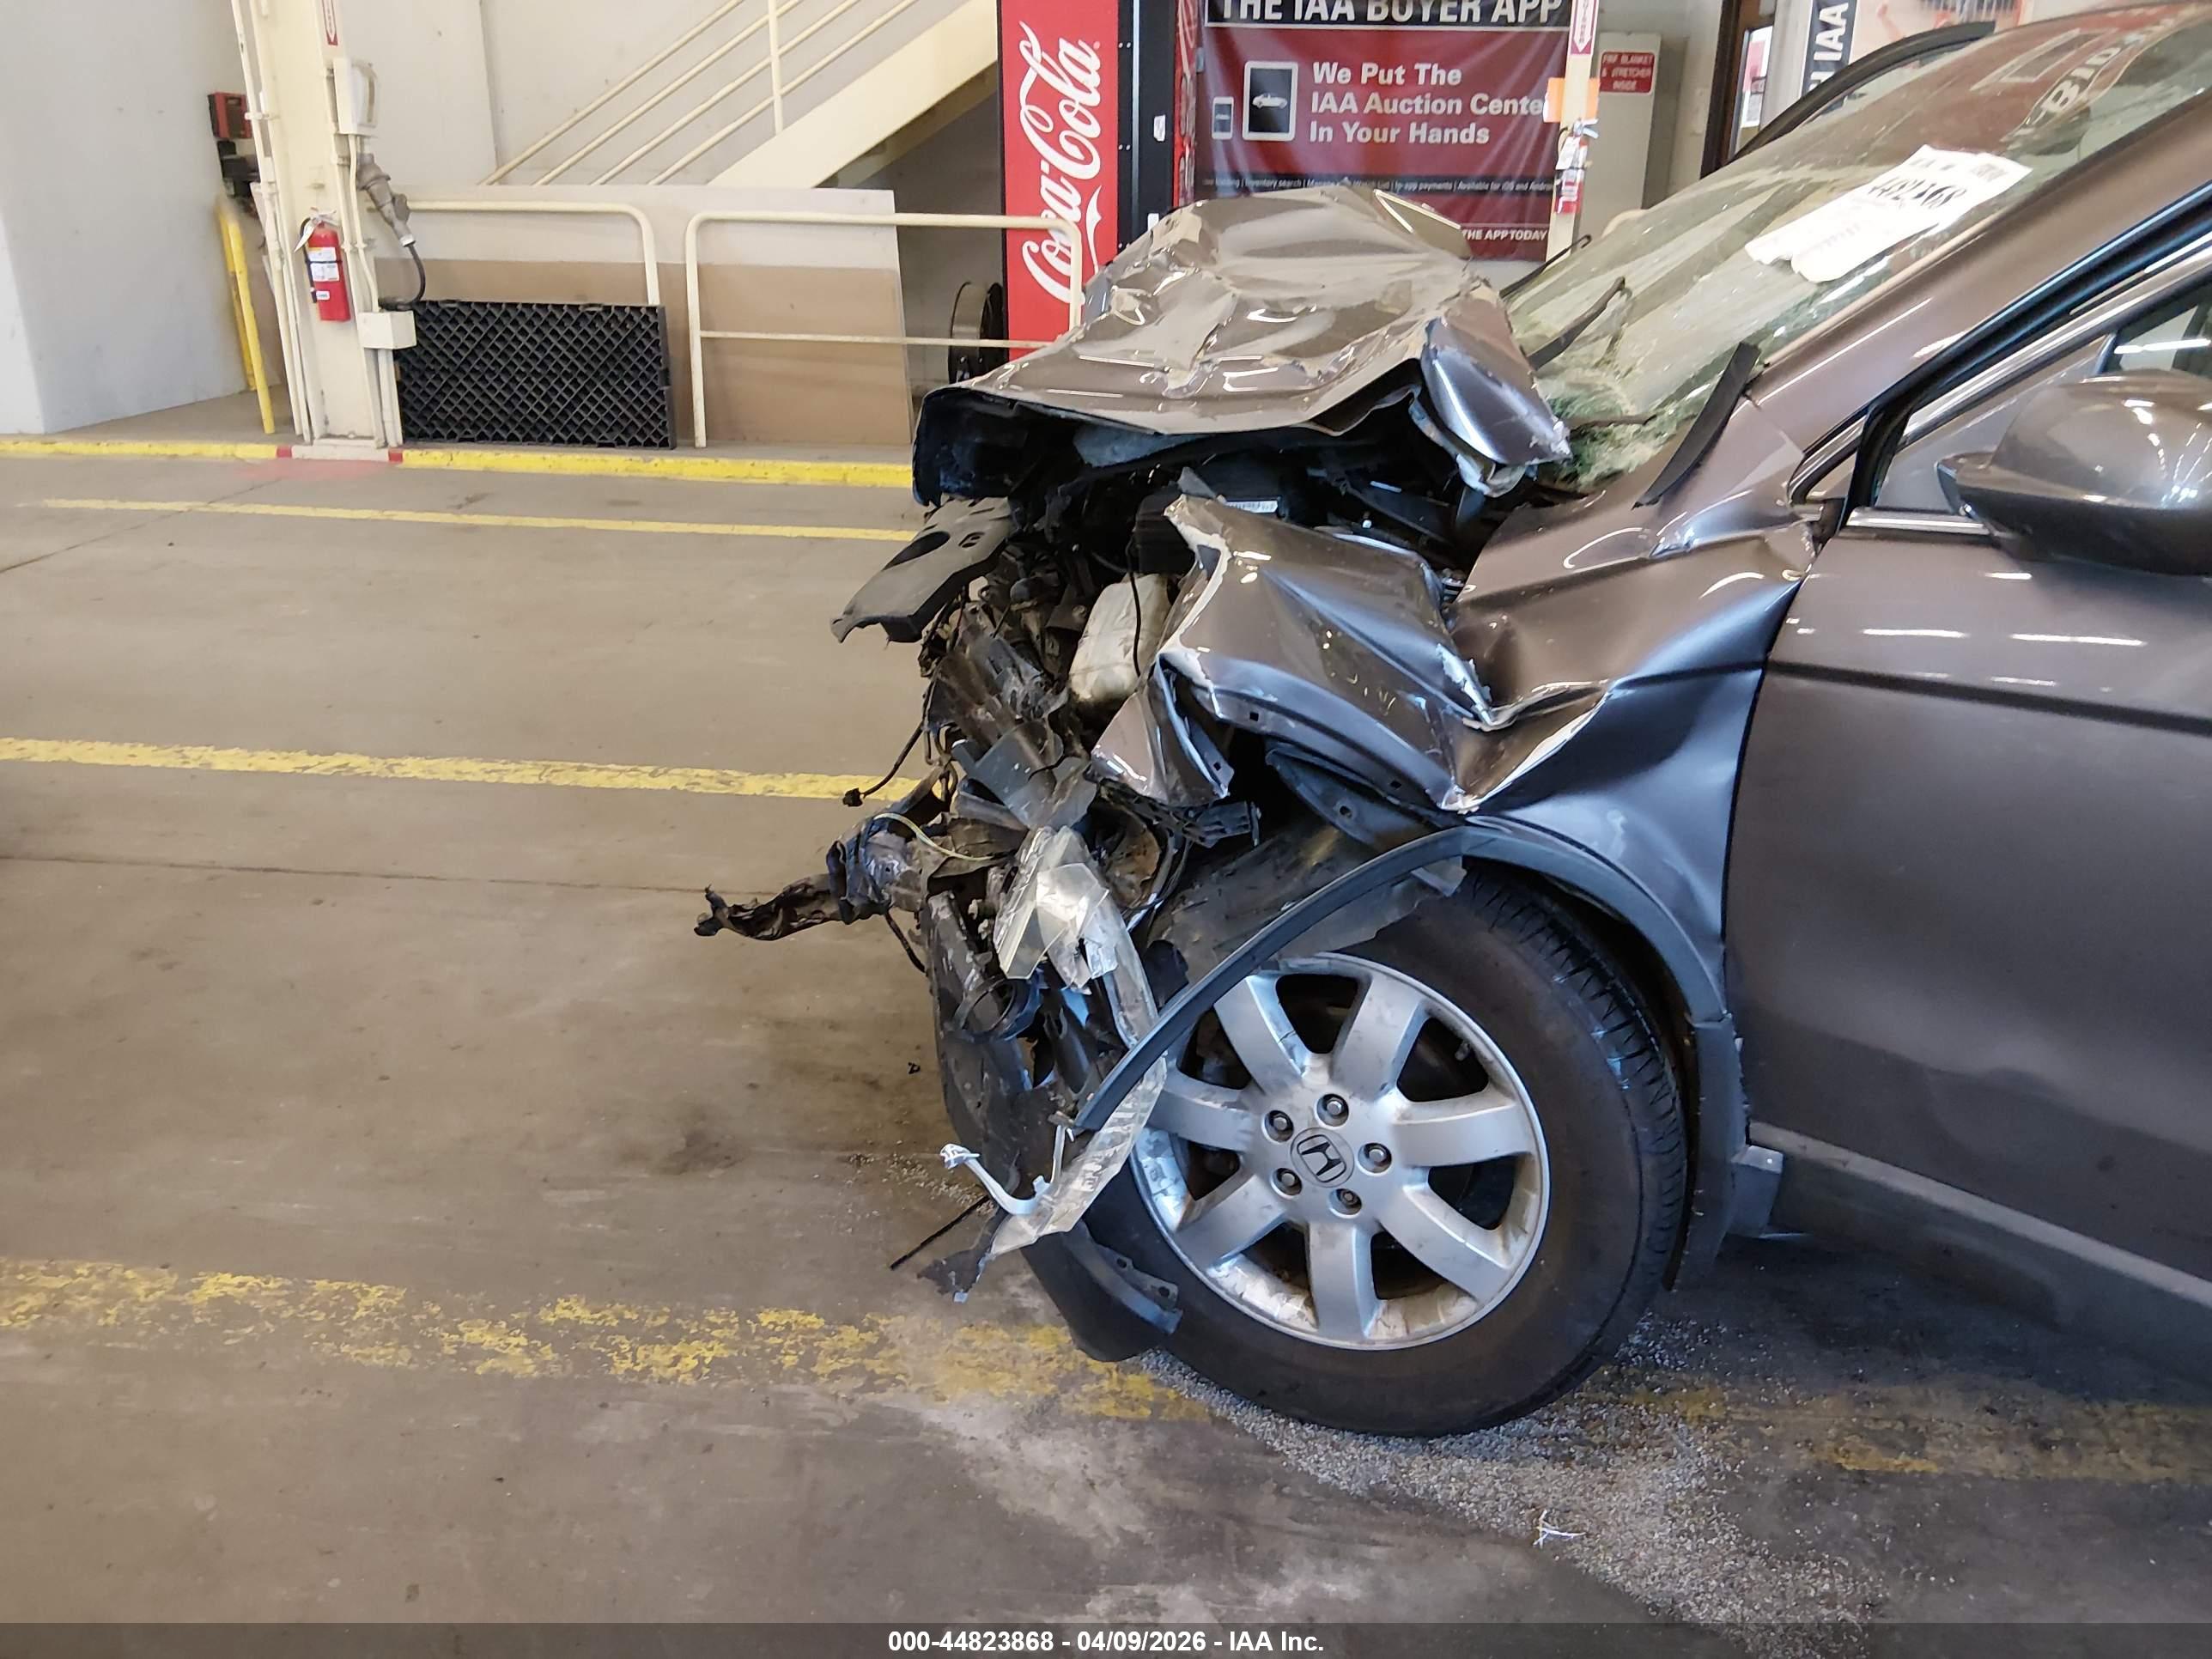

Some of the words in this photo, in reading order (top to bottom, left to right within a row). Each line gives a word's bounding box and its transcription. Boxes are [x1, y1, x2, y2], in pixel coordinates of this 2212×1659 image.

[1367, 0, 1480, 22] BUYER
[1491, 0, 1561, 22] APP
[1814, 3, 1849, 61] IAA
[1312, 62, 1352, 84] We
[1361, 63, 1406, 85] Put
[1414, 64, 1462, 85] The
[1311, 91, 1358, 113] IAA
[1363, 92, 1462, 115] Auction
[1470, 94, 1544, 115] Cente
[1310, 121, 1333, 142] In
[1342, 122, 1400, 143] Your
[1409, 123, 1490, 144] Hands
[1019, 21, 1102, 304] Coca-Cola
[1484, 229, 1509, 240] APP
[1510, 229, 1547, 240] TODAY
